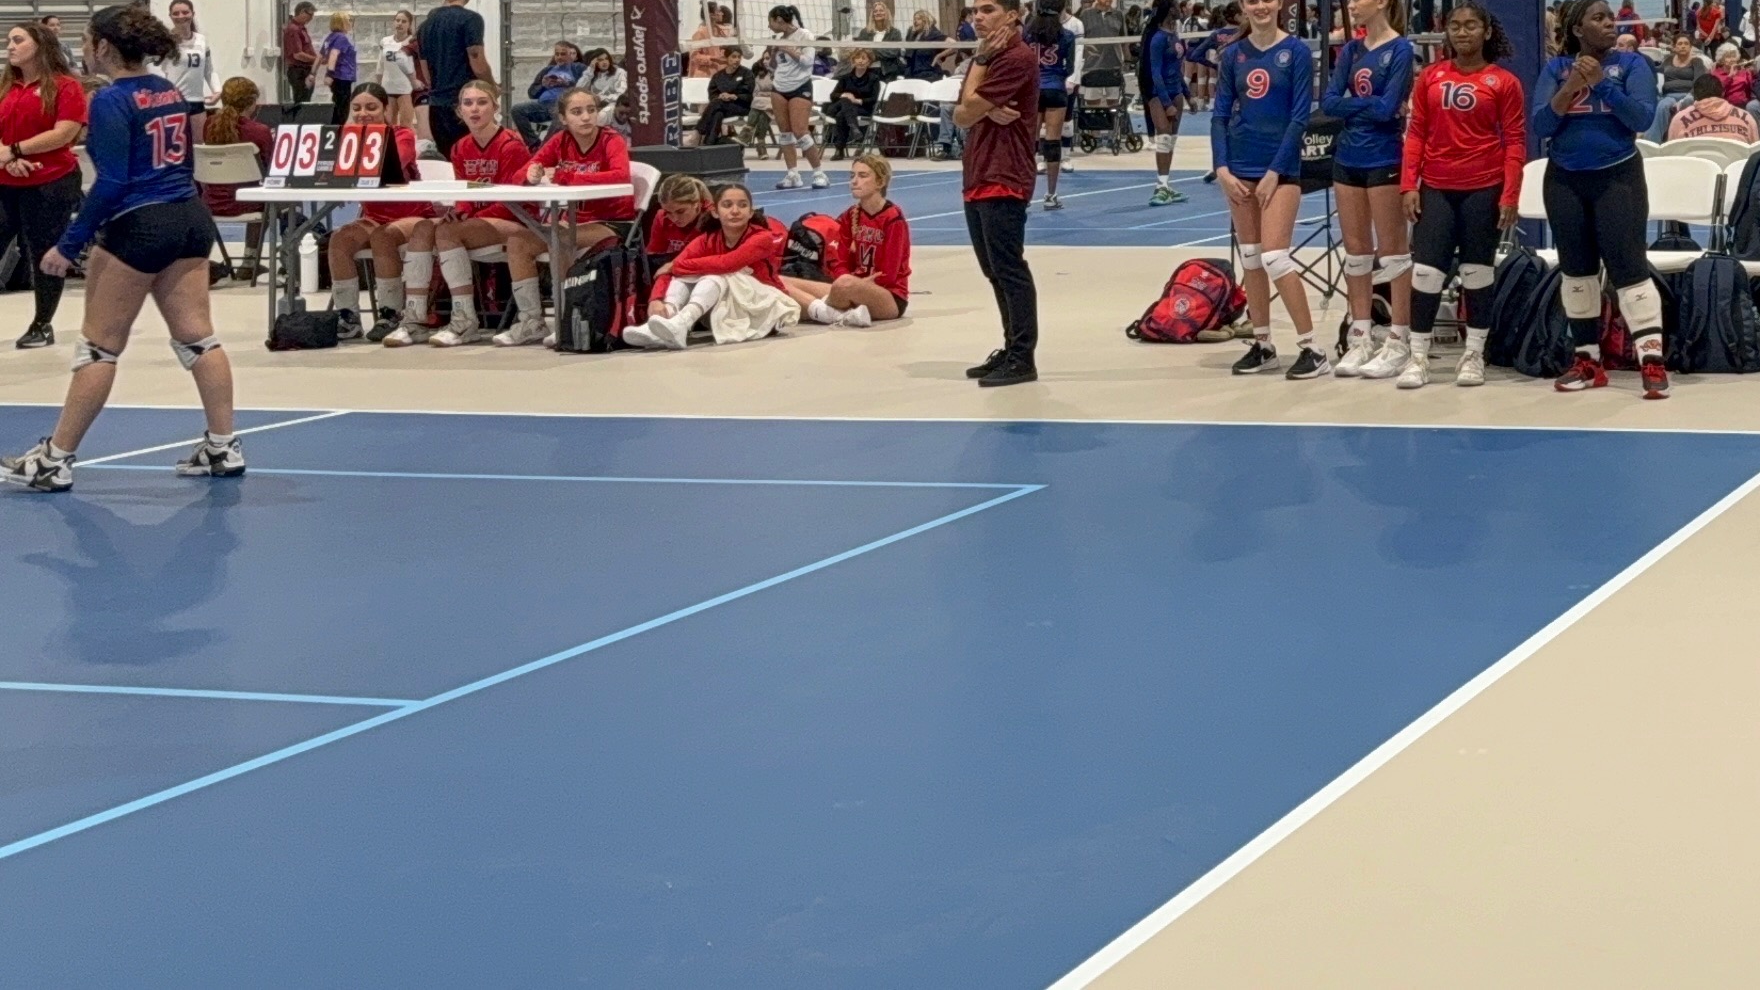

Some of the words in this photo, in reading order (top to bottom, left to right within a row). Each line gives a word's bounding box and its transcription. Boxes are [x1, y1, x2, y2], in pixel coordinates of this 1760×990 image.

[187, 52, 200, 68] 13
[631, 22, 648, 77] jaypro
[1246, 67, 1270, 99] 9
[1354, 67, 1373, 97] 6
[1440, 80, 1478, 112] 16
[635, 77, 652, 125] sports
[145, 112, 188, 170] 13
[275, 132, 318, 170] 03
[324, 131, 336, 150] 2
[339, 131, 382, 170] 03
